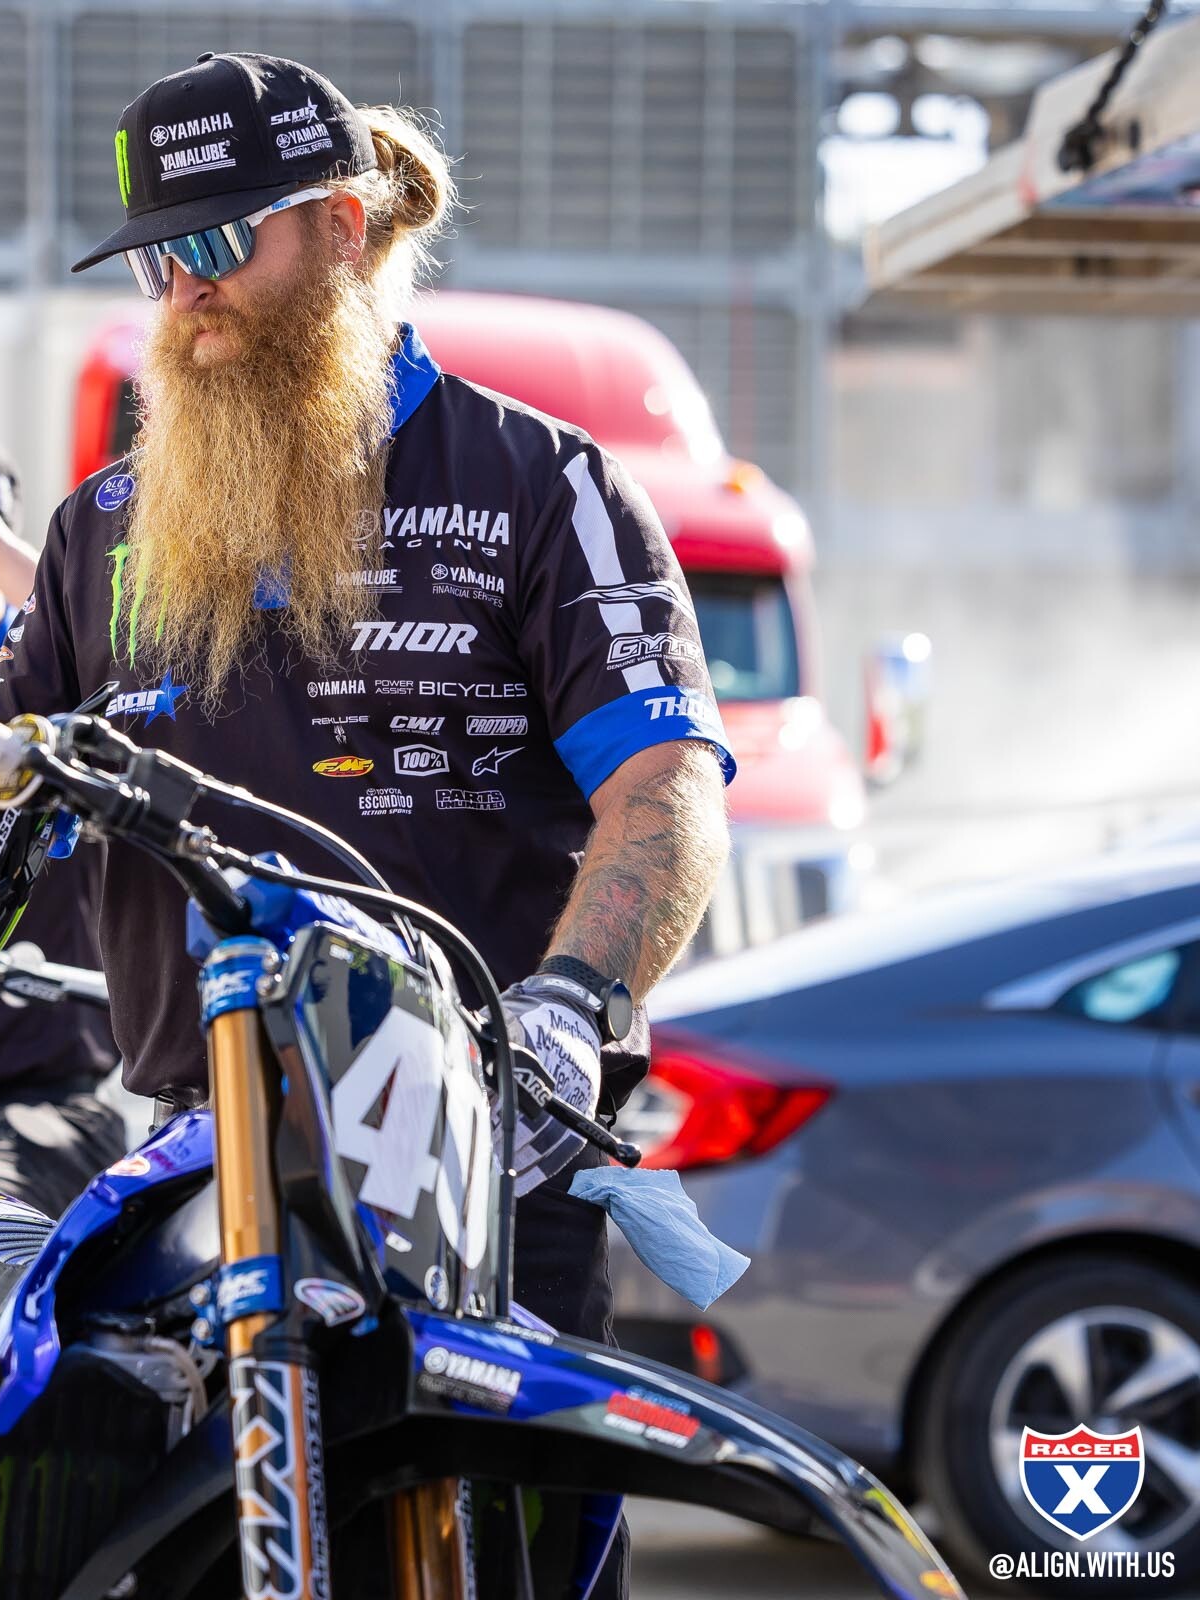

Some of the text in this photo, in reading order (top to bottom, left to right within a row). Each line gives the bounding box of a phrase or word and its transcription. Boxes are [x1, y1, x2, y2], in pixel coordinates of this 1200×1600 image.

[167, 112, 234, 142] YAMAHA
[288, 123, 330, 144] YAMAHA
[160, 141, 228, 172] YAMALUBE
[383, 503, 510, 545] YAMAHA
[351, 538, 498, 557] RACING
[334, 568, 398, 586] YAMALUBE
[450, 567, 505, 595] YAMAHA
[432, 585, 471, 599] FINANCIAL
[350, 621, 479, 654] THOR
[606, 658, 636, 671] GENUINE
[637, 653, 663, 662] YAMAHA
[318, 680, 366, 696] YAMAHA
[375, 681, 528, 698] ASSIST BICYCLES
[105, 690, 166, 718] star
[125, 705, 155, 714] racing
[644, 696, 712, 720] THO
[311, 715, 369, 725] REKLUSE
[468, 718, 527, 734] PROTAPER
[313, 759, 373, 772] FMF
[402, 752, 442, 768] 100%
[359, 795, 413, 809] ESCONDIDO
[436, 789, 504, 803] PARTS
[513, 1067, 553, 1108] ARC
[331, 1006, 491, 1270] 40
